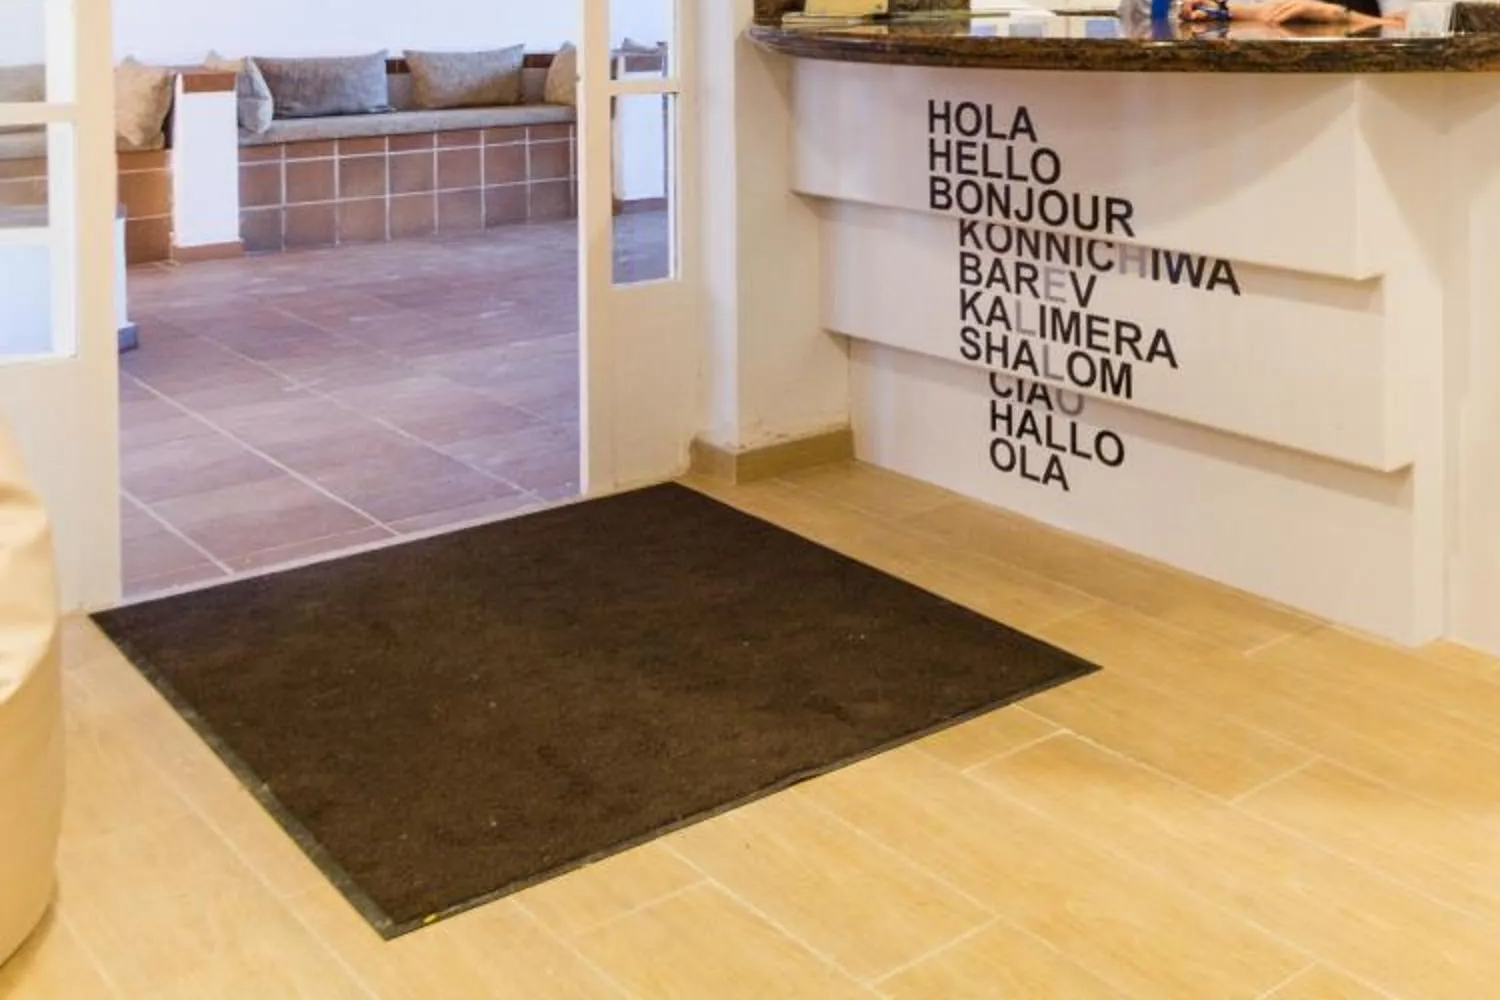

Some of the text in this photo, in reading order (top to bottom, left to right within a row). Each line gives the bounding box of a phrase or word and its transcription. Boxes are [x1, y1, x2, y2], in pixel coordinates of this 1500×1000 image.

[928, 99, 1037, 143] HOLA
[929, 137, 1061, 185] HELLO
[929, 175, 1135, 238] BONJOUR
[959, 217, 1241, 296] KONNICHIWA
[959, 251, 1097, 309] BAREV
[960, 288, 1178, 369] KALIMERA
[960, 326, 1133, 400] SHALOM
[989, 372, 1085, 417] CIAO
[989, 437, 1070, 491] OLA
[990, 400, 1125, 468] HALLO
